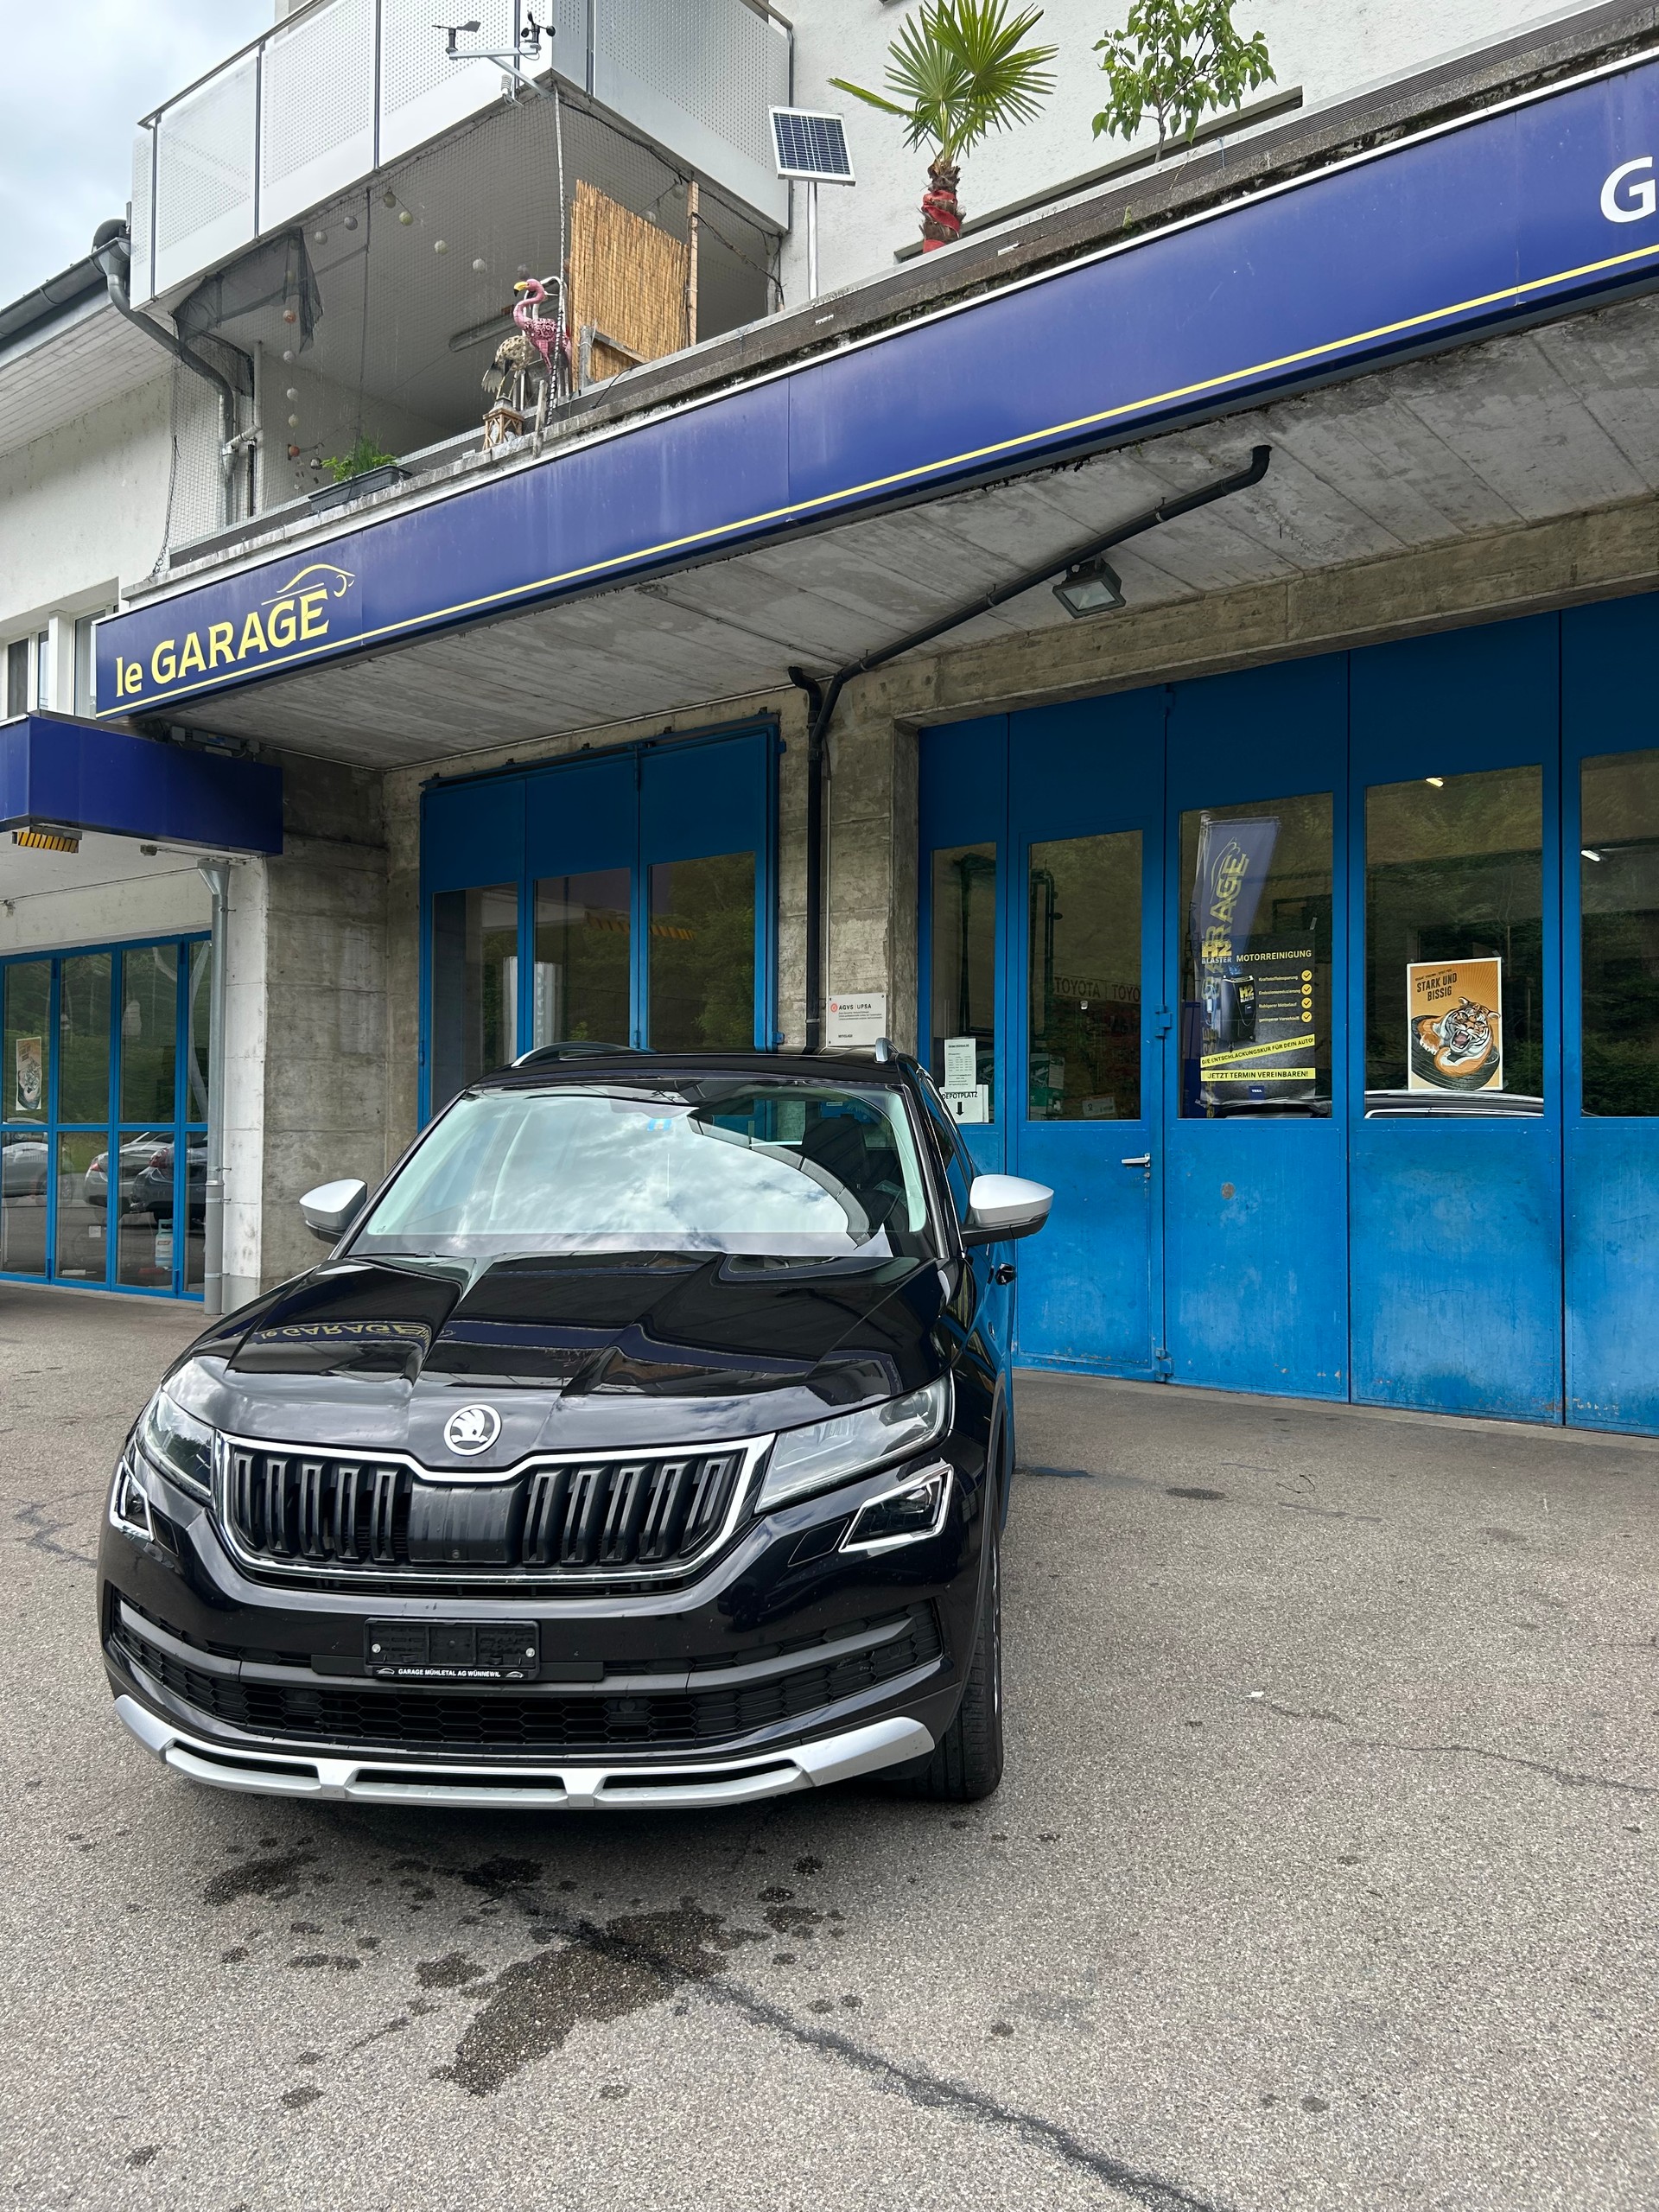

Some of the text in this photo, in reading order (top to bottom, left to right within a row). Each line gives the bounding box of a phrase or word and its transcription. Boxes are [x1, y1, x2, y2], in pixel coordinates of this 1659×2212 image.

[1599, 156, 1657, 224] G
[116, 588, 330, 698] le GARAGE
[1201, 939, 1232, 958] H2
[1236, 950, 1313, 963] MOTORREINIGUNG
[1201, 957, 1232, 965] BLASTER
[1053, 976, 1101, 999] TOYOTA
[1416, 976, 1441, 993] STARK
[1442, 972, 1458, 986] UND
[1427, 985, 1452, 1001] BISSIG
[1201, 1057, 1211, 1065] DIE
[1211, 1046, 1272, 1063] ENTSCHLACKUNGSKUR
[1272, 1043, 1283, 1052] FÜR
[1297, 1037, 1314, 1046] AUTO!
[942, 1091, 978, 1100] DEPOTPLATZ
[424, 1668, 457, 1676] MÜHLETAL
[467, 1669, 501, 1678] WÜNNEWIL
